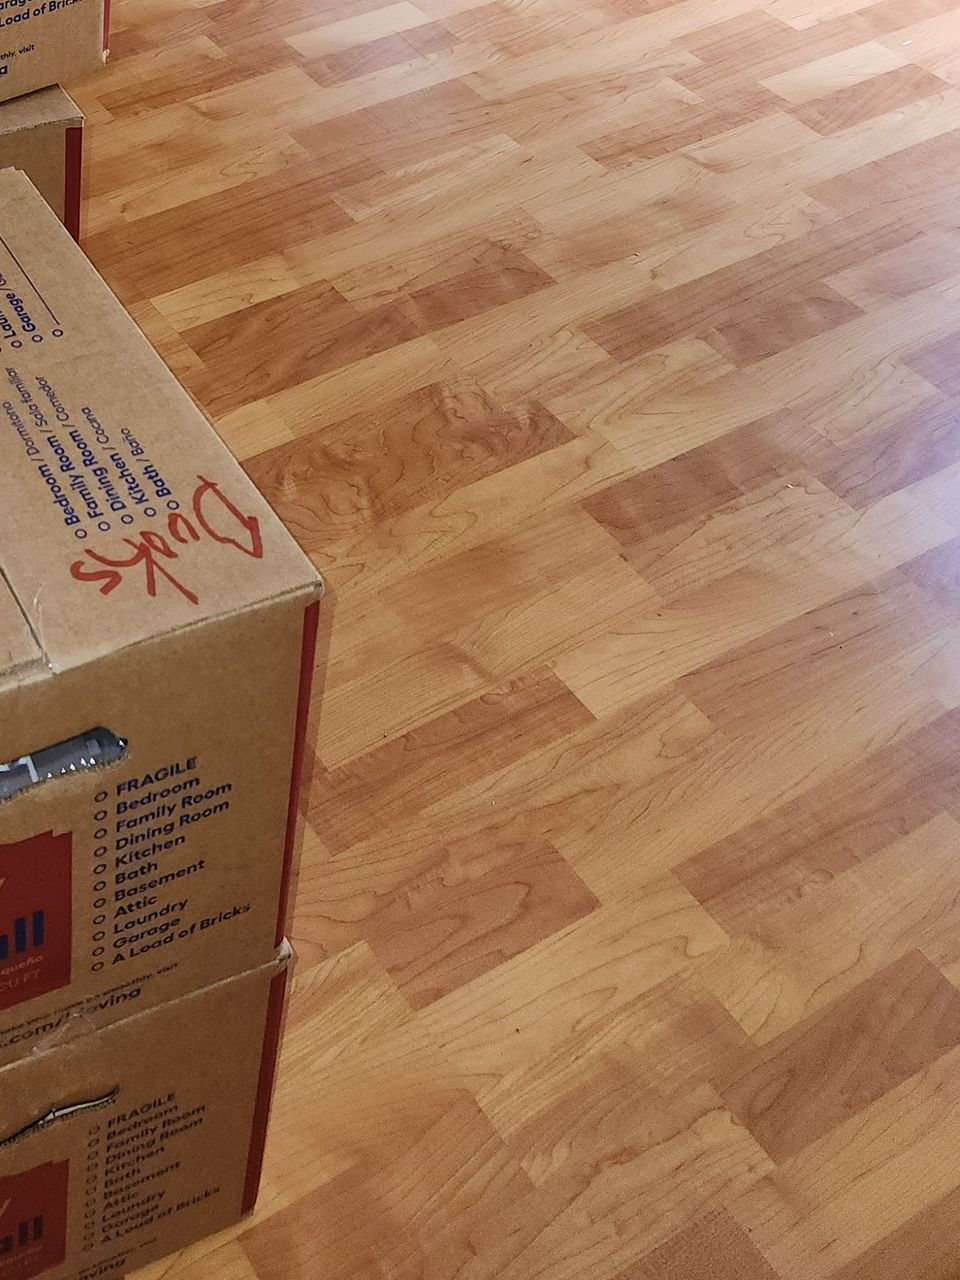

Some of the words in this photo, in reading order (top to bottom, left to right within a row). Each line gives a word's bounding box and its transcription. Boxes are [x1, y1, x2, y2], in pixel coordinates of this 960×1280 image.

[33, 1, 47, 16] of
[19, 43, 35, 55] visit
[6, 293, 36, 333] Garage
[5, 367, 33, 405] familiar
[35, 376, 69, 422] Comedor
[2, 401, 40, 456] Dormitorio
[28, 403, 48, 427] Sala
[81, 406, 109, 444] Cocina
[47, 435, 75, 473] Room
[69, 429, 99, 466] Room
[121, 427, 144, 457] Baño
[38, 464, 80, 526] Bedroom
[69, 474, 104, 519] Family
[93, 467, 127, 512] Dining
[110, 452, 149, 505] Kitchen
[142, 464, 172, 498] Bath
[116, 756, 198, 796] FRAGILE
[116, 777, 200, 815] Bedroom
[116, 804, 177, 833] Family
[181, 783, 232, 808] Room
[115, 822, 174, 851] Dining
[179, 801, 230, 827] Room
[115, 836, 186, 868] Kitchen
[114, 860, 206, 902] Basement
[115, 862, 158, 885] Bath
[113, 899, 188, 934] Laundry
[114, 895, 158, 919] Attic
[111, 952, 125, 965] A
[129, 933, 174, 958] Load
[178, 923, 197, 939] of
[200, 903, 251, 930] Bricks
[113, 918, 181, 949] Garage
[108, 1093, 175, 1128] FRAGILE
